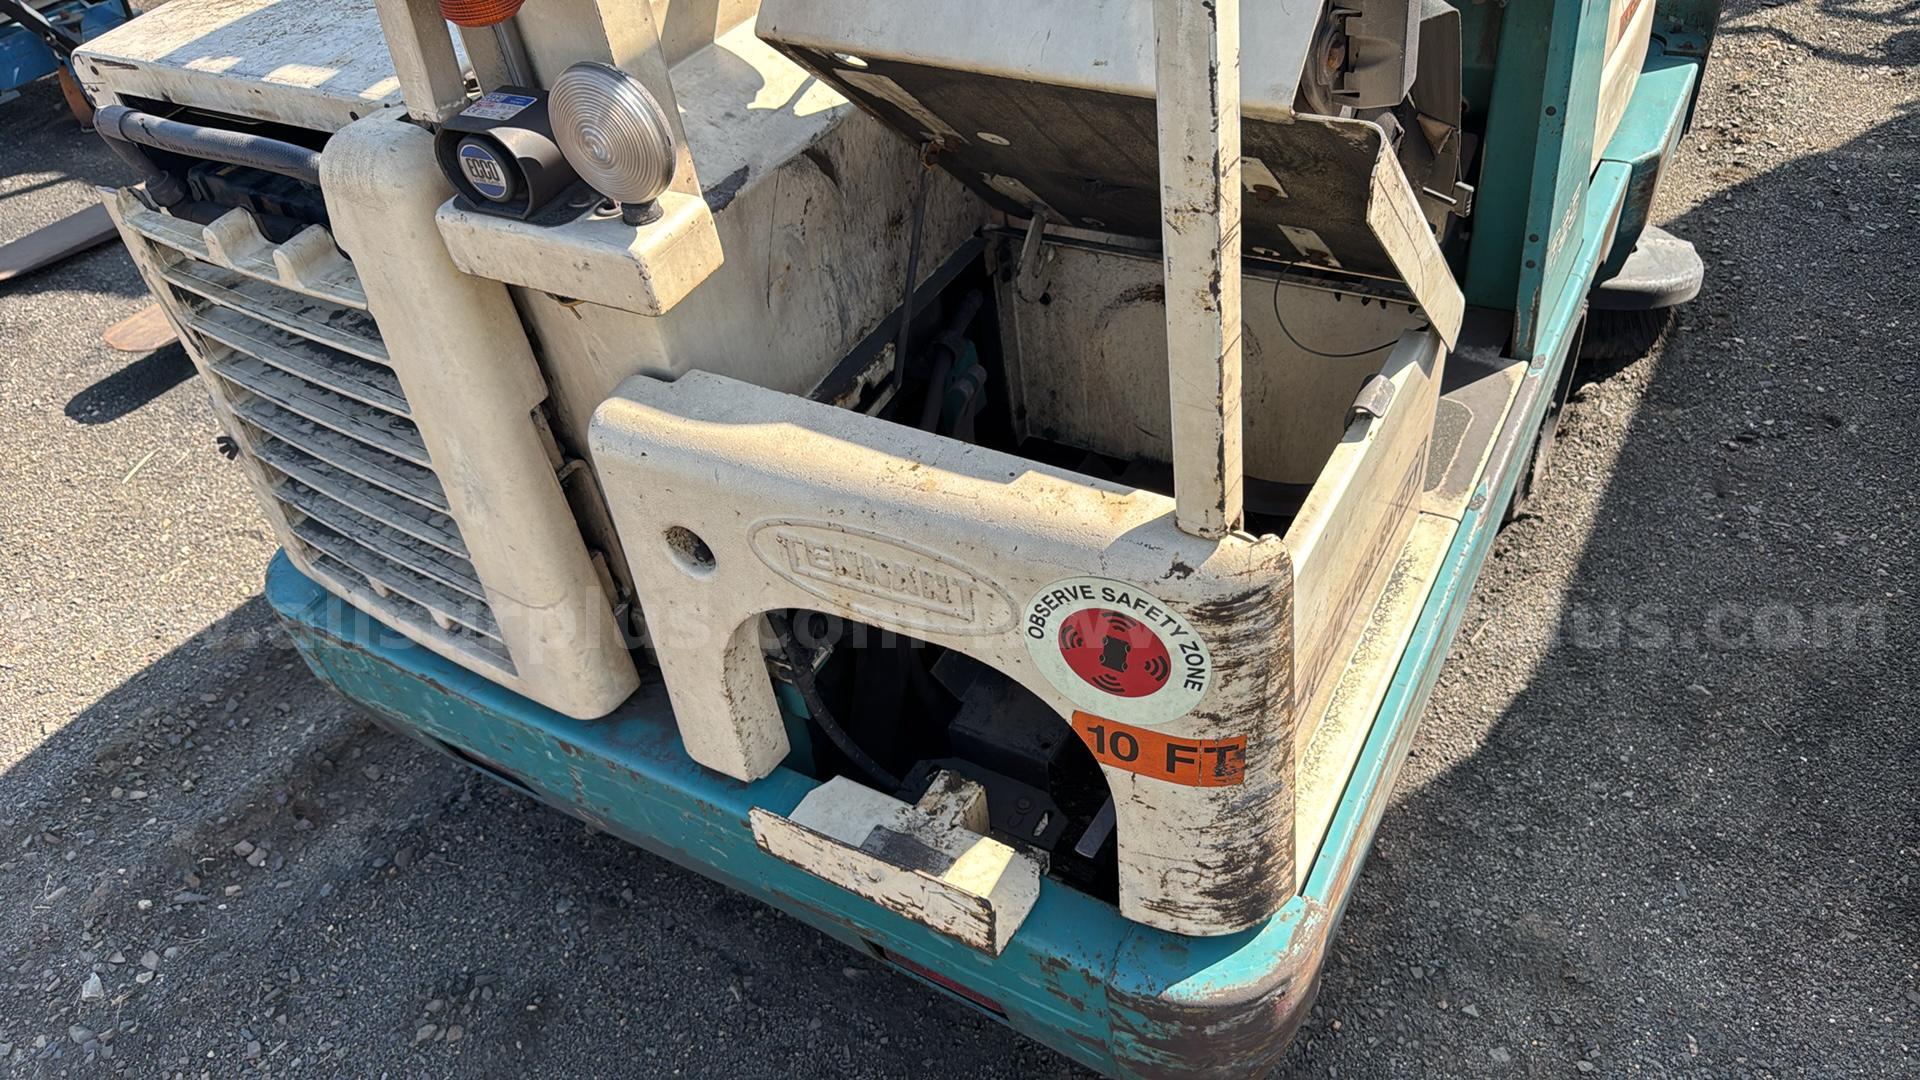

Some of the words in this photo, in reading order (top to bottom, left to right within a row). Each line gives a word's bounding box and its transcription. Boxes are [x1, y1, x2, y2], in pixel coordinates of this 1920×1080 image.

[466, 158, 500, 181] ECCO
[776, 528, 979, 623] TENNANT
[1028, 584, 1095, 640] OBSERVE
[1101, 587, 1188, 638] SAFETY
[1179, 641, 1206, 692] ZONE
[1087, 725, 1139, 762] 10
[1166, 743, 1240, 777] FT
